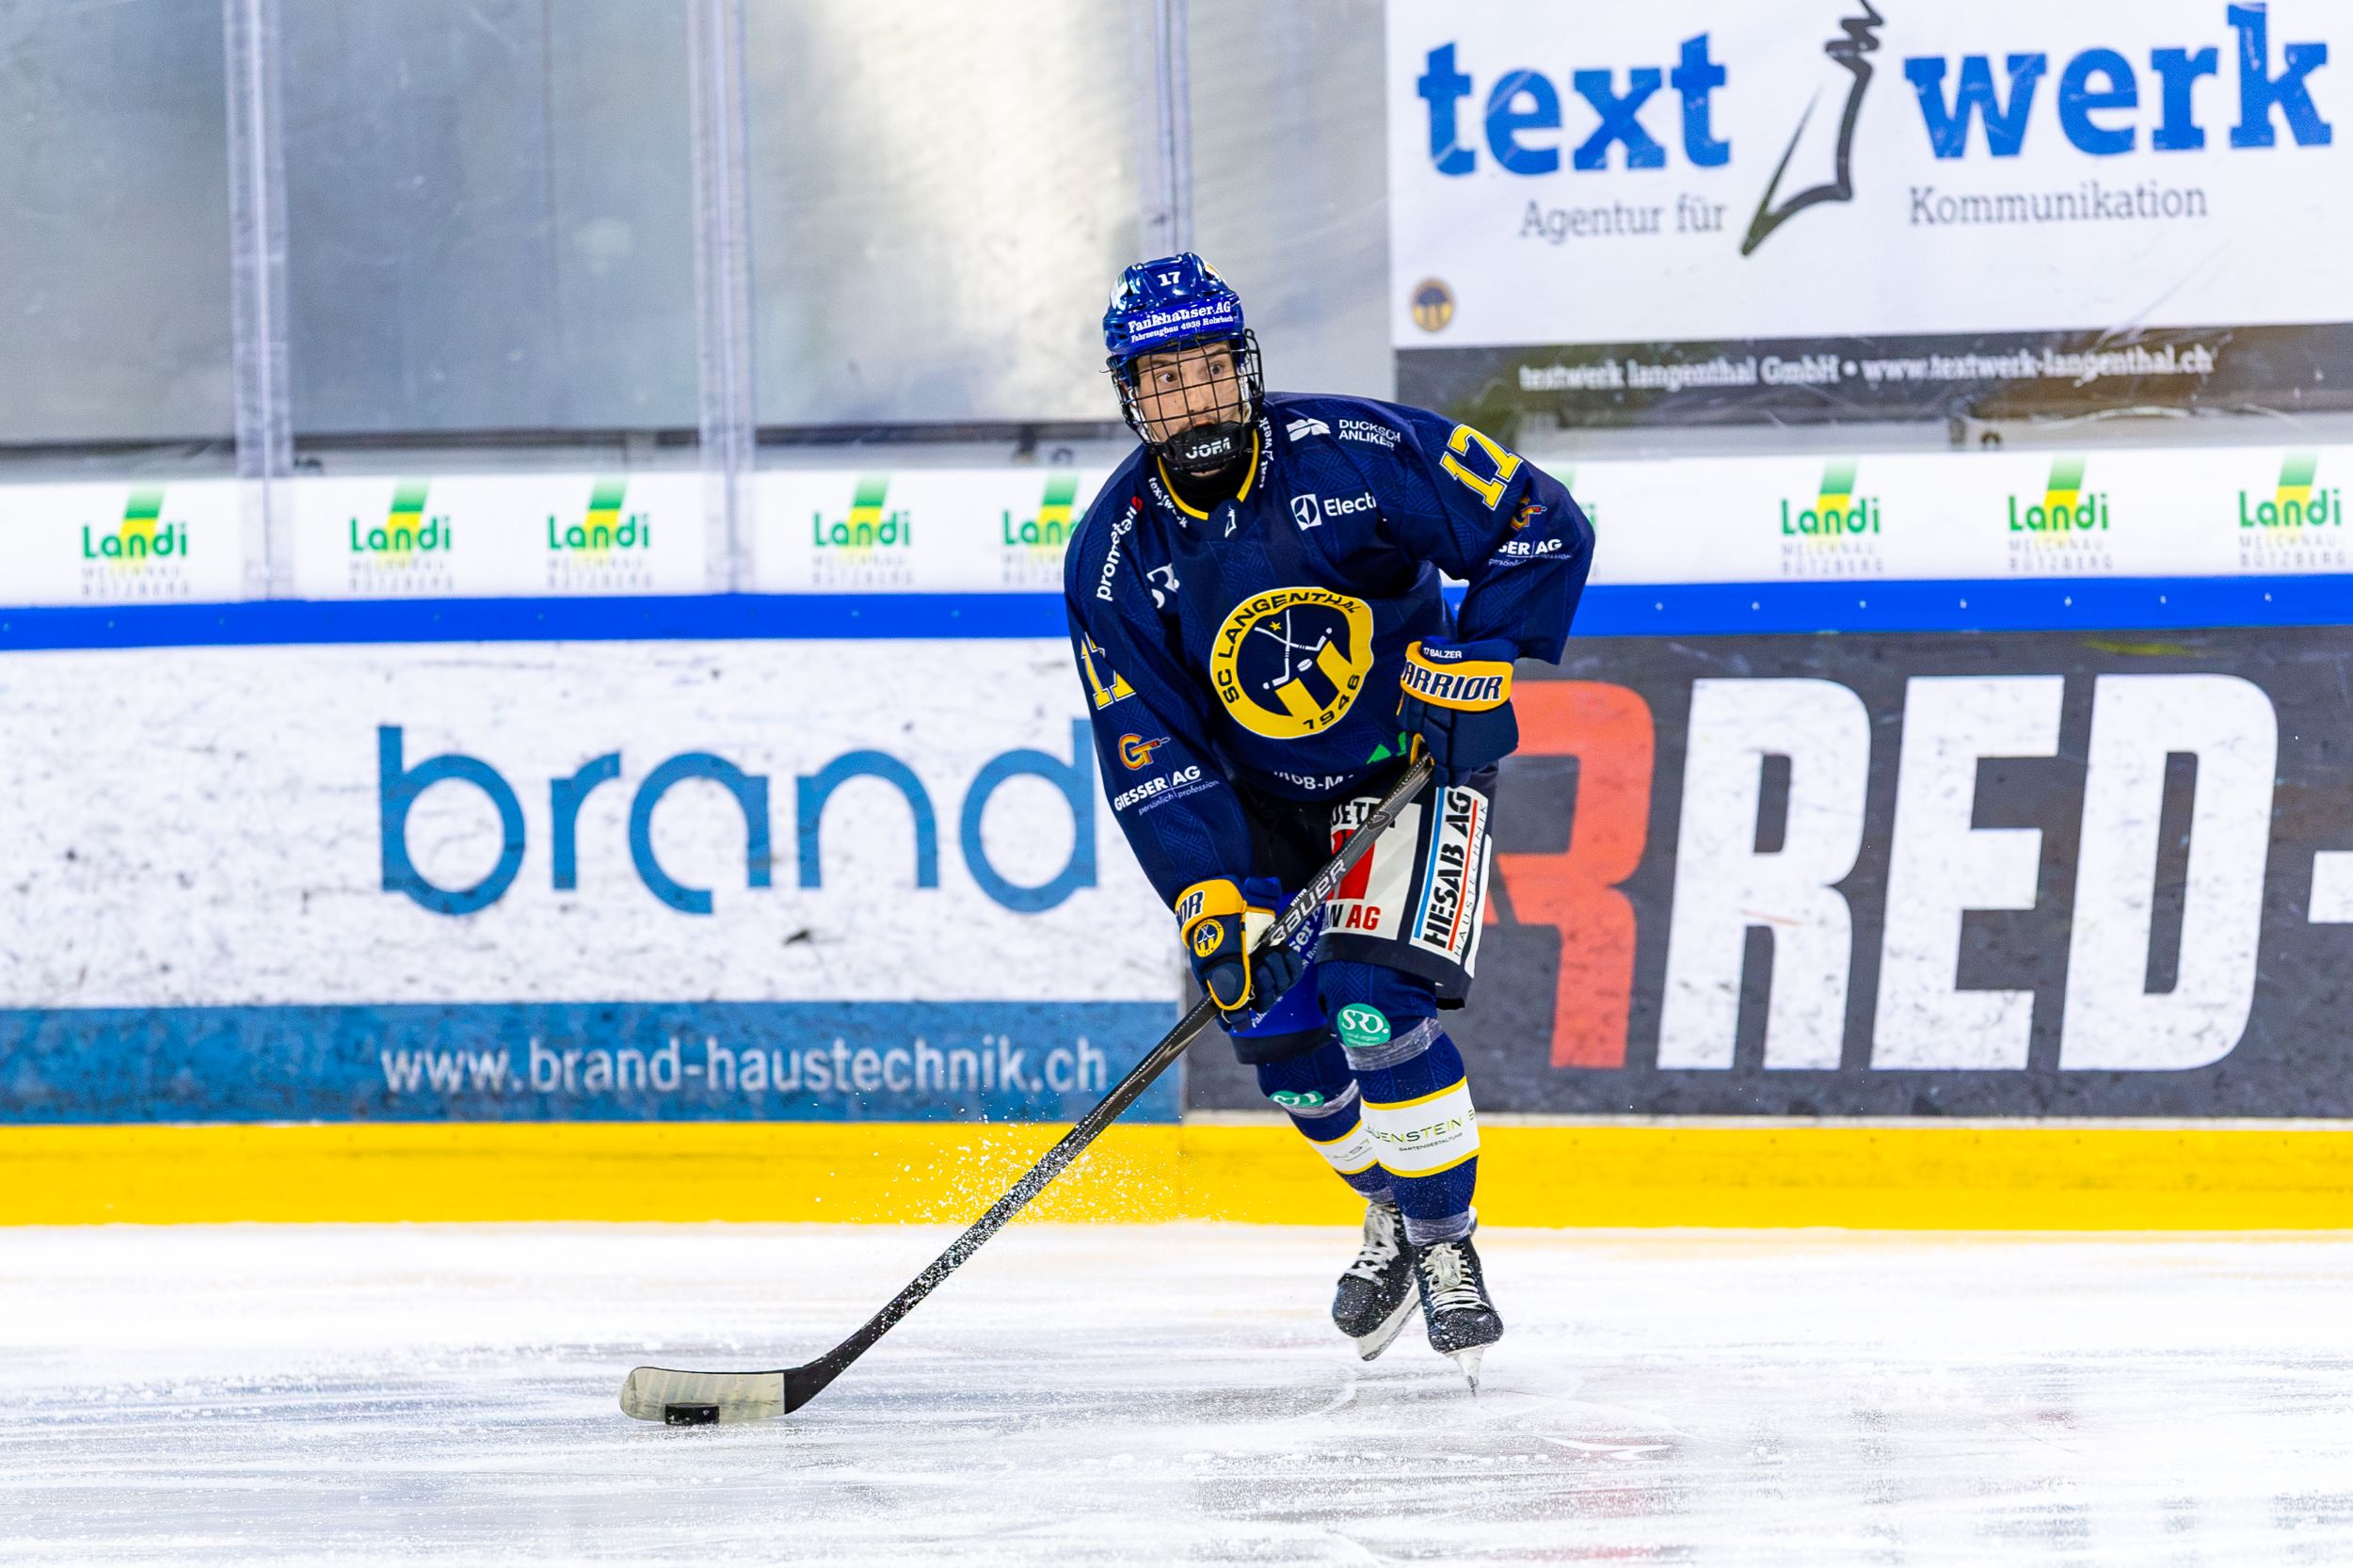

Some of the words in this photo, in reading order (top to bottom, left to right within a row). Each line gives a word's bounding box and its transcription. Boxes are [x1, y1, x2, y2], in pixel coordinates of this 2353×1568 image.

[1417, 32, 1730, 176] text
[1905, 1, 2331, 161] werk
[1520, 199, 1664, 246] Agentur
[1675, 192, 1728, 234] für
[1909, 180, 2209, 226] Kommunikation
[1157, 271, 1181, 286] 17
[1215, 300, 1231, 314] AG
[1439, 423, 1525, 512] 17
[1782, 496, 1881, 535] Landi
[2008, 493, 2108, 532] Landi
[2239, 488, 2342, 527] Landi
[82, 520, 187, 558] Landi
[351, 514, 451, 552] Landi
[549, 512, 649, 550] Landi
[813, 510, 910, 547] Landi
[1535, 538, 1562, 554] AG
[1218, 592, 1362, 659] LANGENTHAL
[1430, 648, 1463, 660] BALZER
[1217, 668, 1241, 704] SC
[1302, 674, 1361, 730] 1946
[1113, 776, 1169, 811] GIESSER
[1172, 765, 1201, 786] AG
[377, 718, 1097, 916] brand
[1445, 790, 1472, 839] AG
[1345, 904, 1381, 931] AG
[379, 1035, 1108, 1094] www.brand-haustechnik.ch
